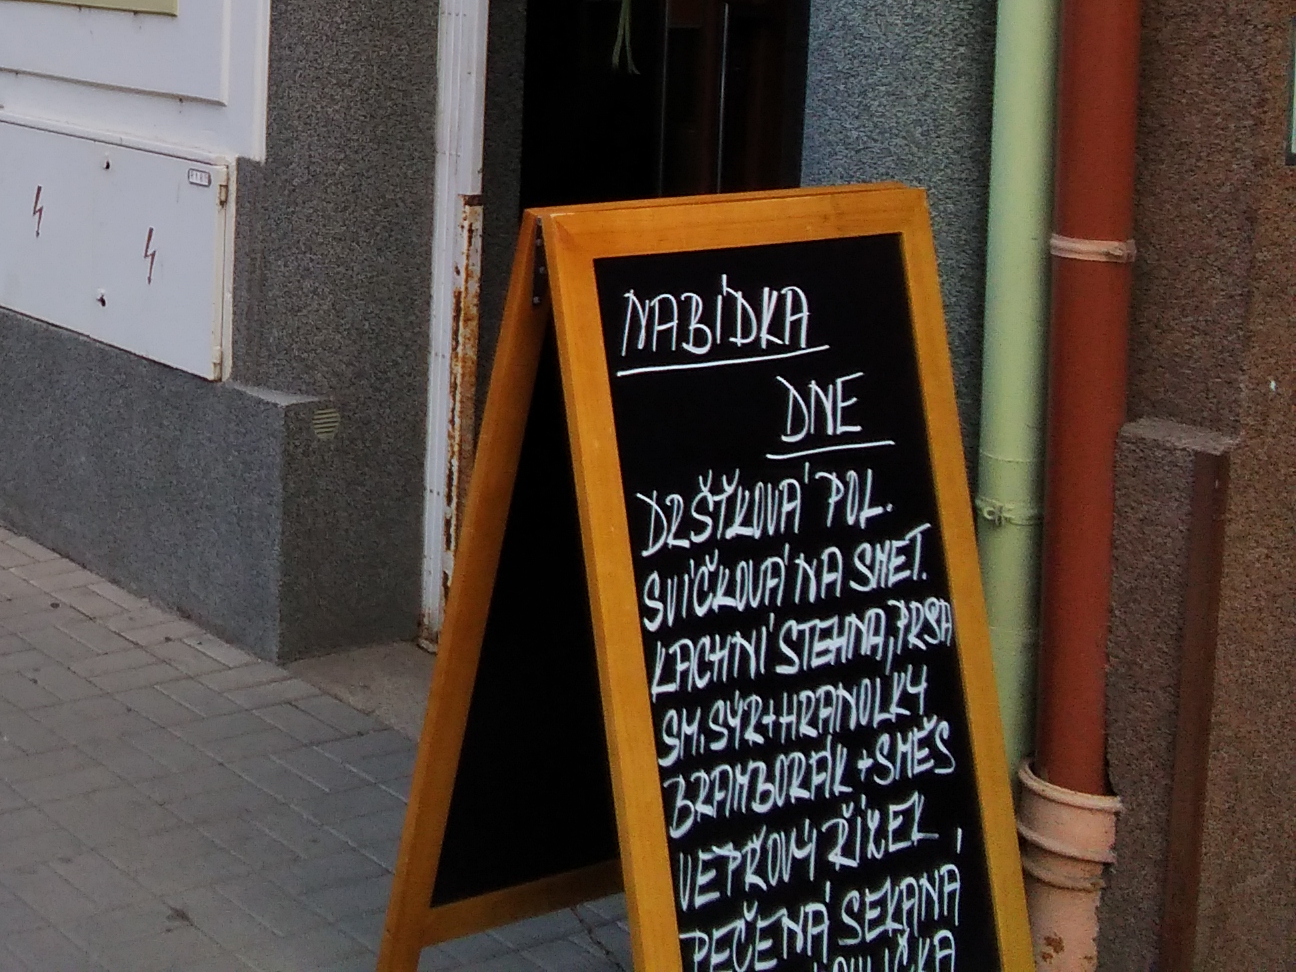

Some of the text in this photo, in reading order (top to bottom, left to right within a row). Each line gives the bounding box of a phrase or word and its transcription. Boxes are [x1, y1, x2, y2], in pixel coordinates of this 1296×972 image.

[620, 274, 810, 357] NABÍDKA
[775, 372, 864, 442] DNE
[814, 468, 895, 529] POL.
[794, 546, 844, 605] NA
